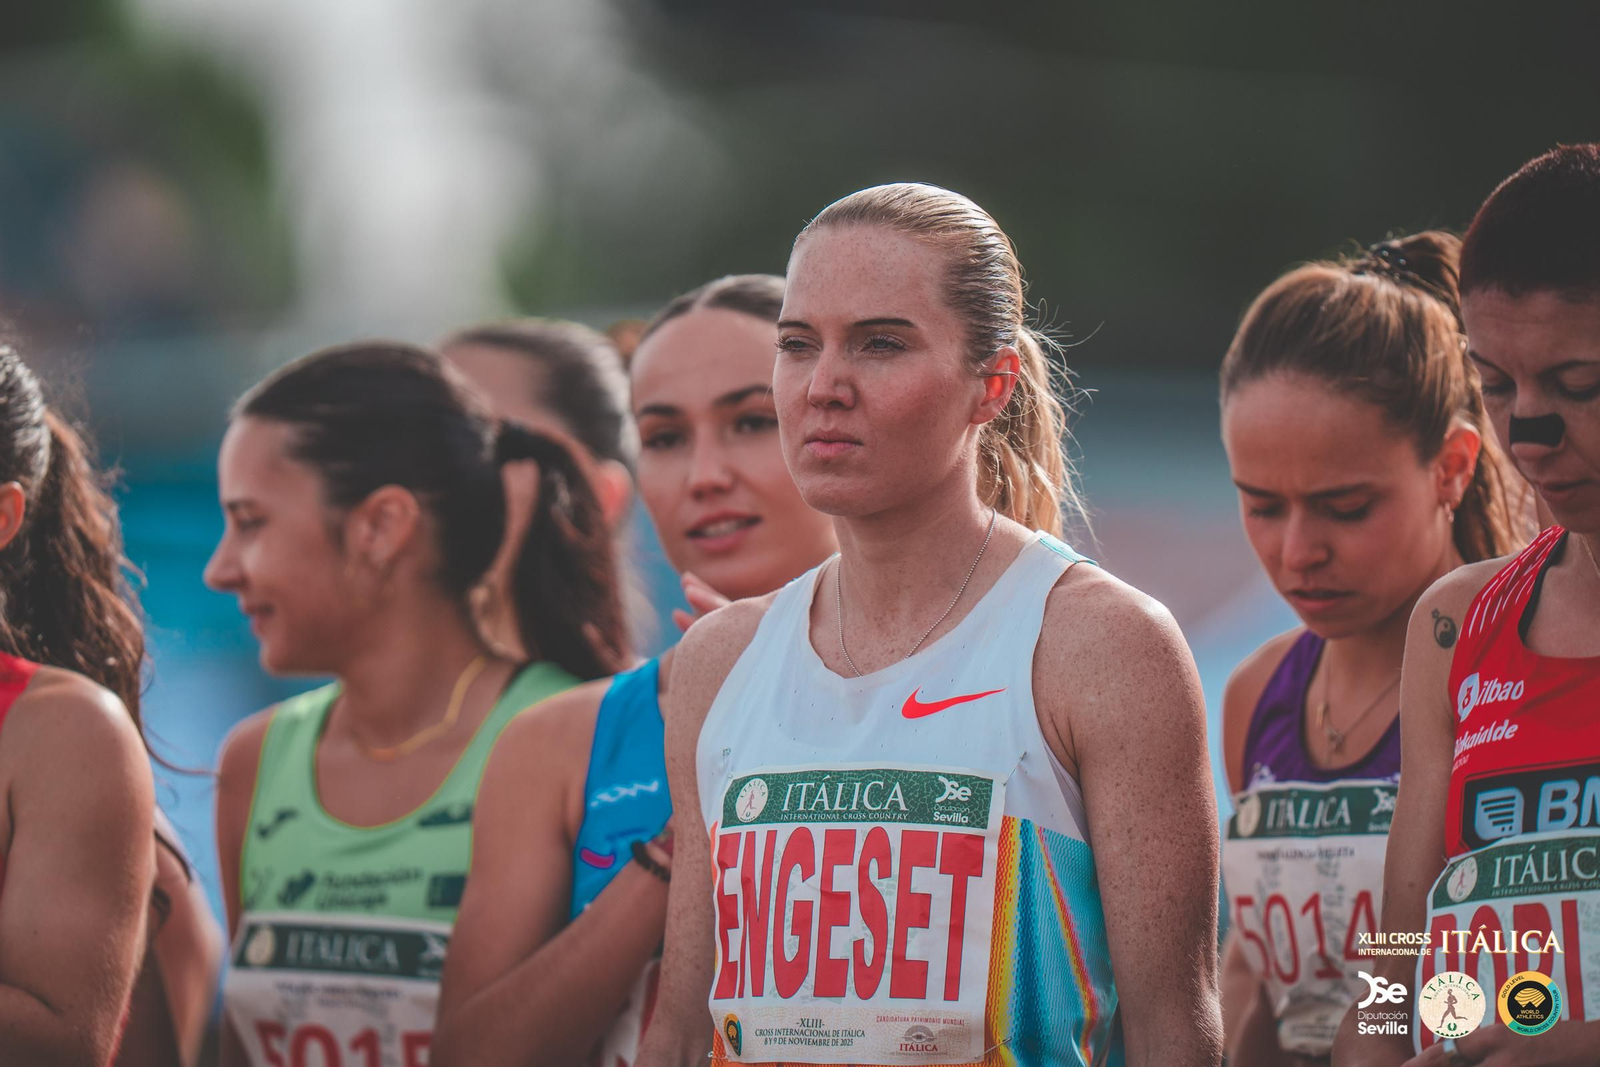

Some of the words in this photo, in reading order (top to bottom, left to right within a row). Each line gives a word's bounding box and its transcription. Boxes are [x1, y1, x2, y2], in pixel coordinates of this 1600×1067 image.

[781, 774, 909, 811] ITÁLICA
[780, 812, 840, 821] INTERNATIONAL
[843, 812, 866, 820] CROSS
[868, 812, 909, 820] COUNTRY
[933, 811, 969, 823] Sevilla
[1493, 844, 1600, 888] ITÁLIC
[713, 826, 985, 1002] ENGESET
[1234, 889, 1379, 985] 5014
[755, 1028, 774, 1037] CROSS
[774, 1028, 831, 1038] INTERNACIONAL
[832, 1029, 840, 1038] DE
[841, 1028, 865, 1038] ITÁLICA
[768, 1037, 773, 1046] Y
[773, 1037, 778, 1046] 9
[778, 1037, 787, 1045] DE
[788, 1037, 830, 1047] NOVIEMBRE
[831, 1038, 839, 1047] DE
[840, 1038, 854, 1046] 2025
[899, 1042, 938, 1052] ITÁLICA
